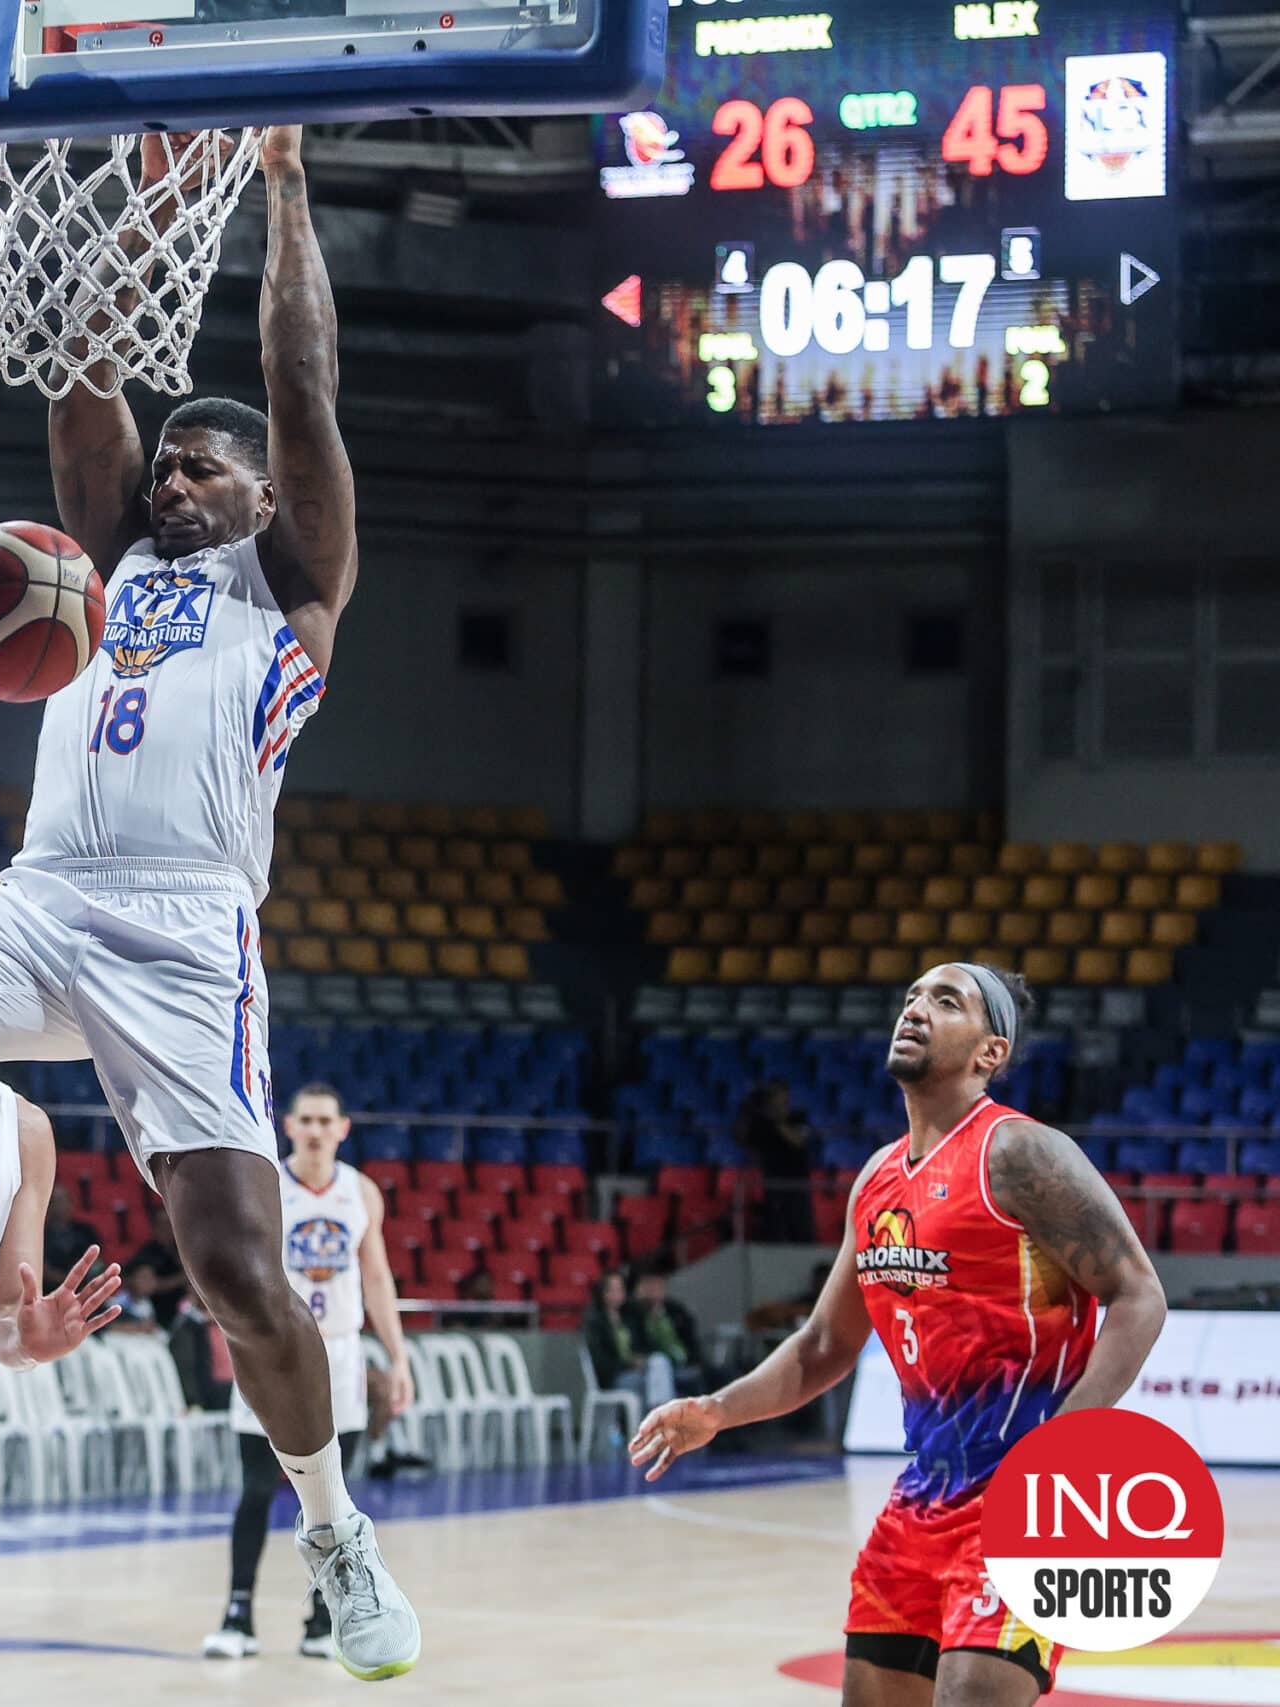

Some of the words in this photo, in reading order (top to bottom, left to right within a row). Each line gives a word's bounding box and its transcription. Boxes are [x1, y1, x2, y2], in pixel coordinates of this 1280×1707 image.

[954, 2, 1040, 40] NLEX
[839, 91, 918, 130] QTR2
[942, 84, 1048, 176] 45
[710, 97, 815, 191] 26
[760, 254, 996, 356] 06:17
[707, 366, 736, 412] 3
[1020, 359, 1049, 405] 2
[89, 686, 147, 755] 18
[310, 1290, 327, 1321] 8
[896, 1309, 918, 1365] 3
